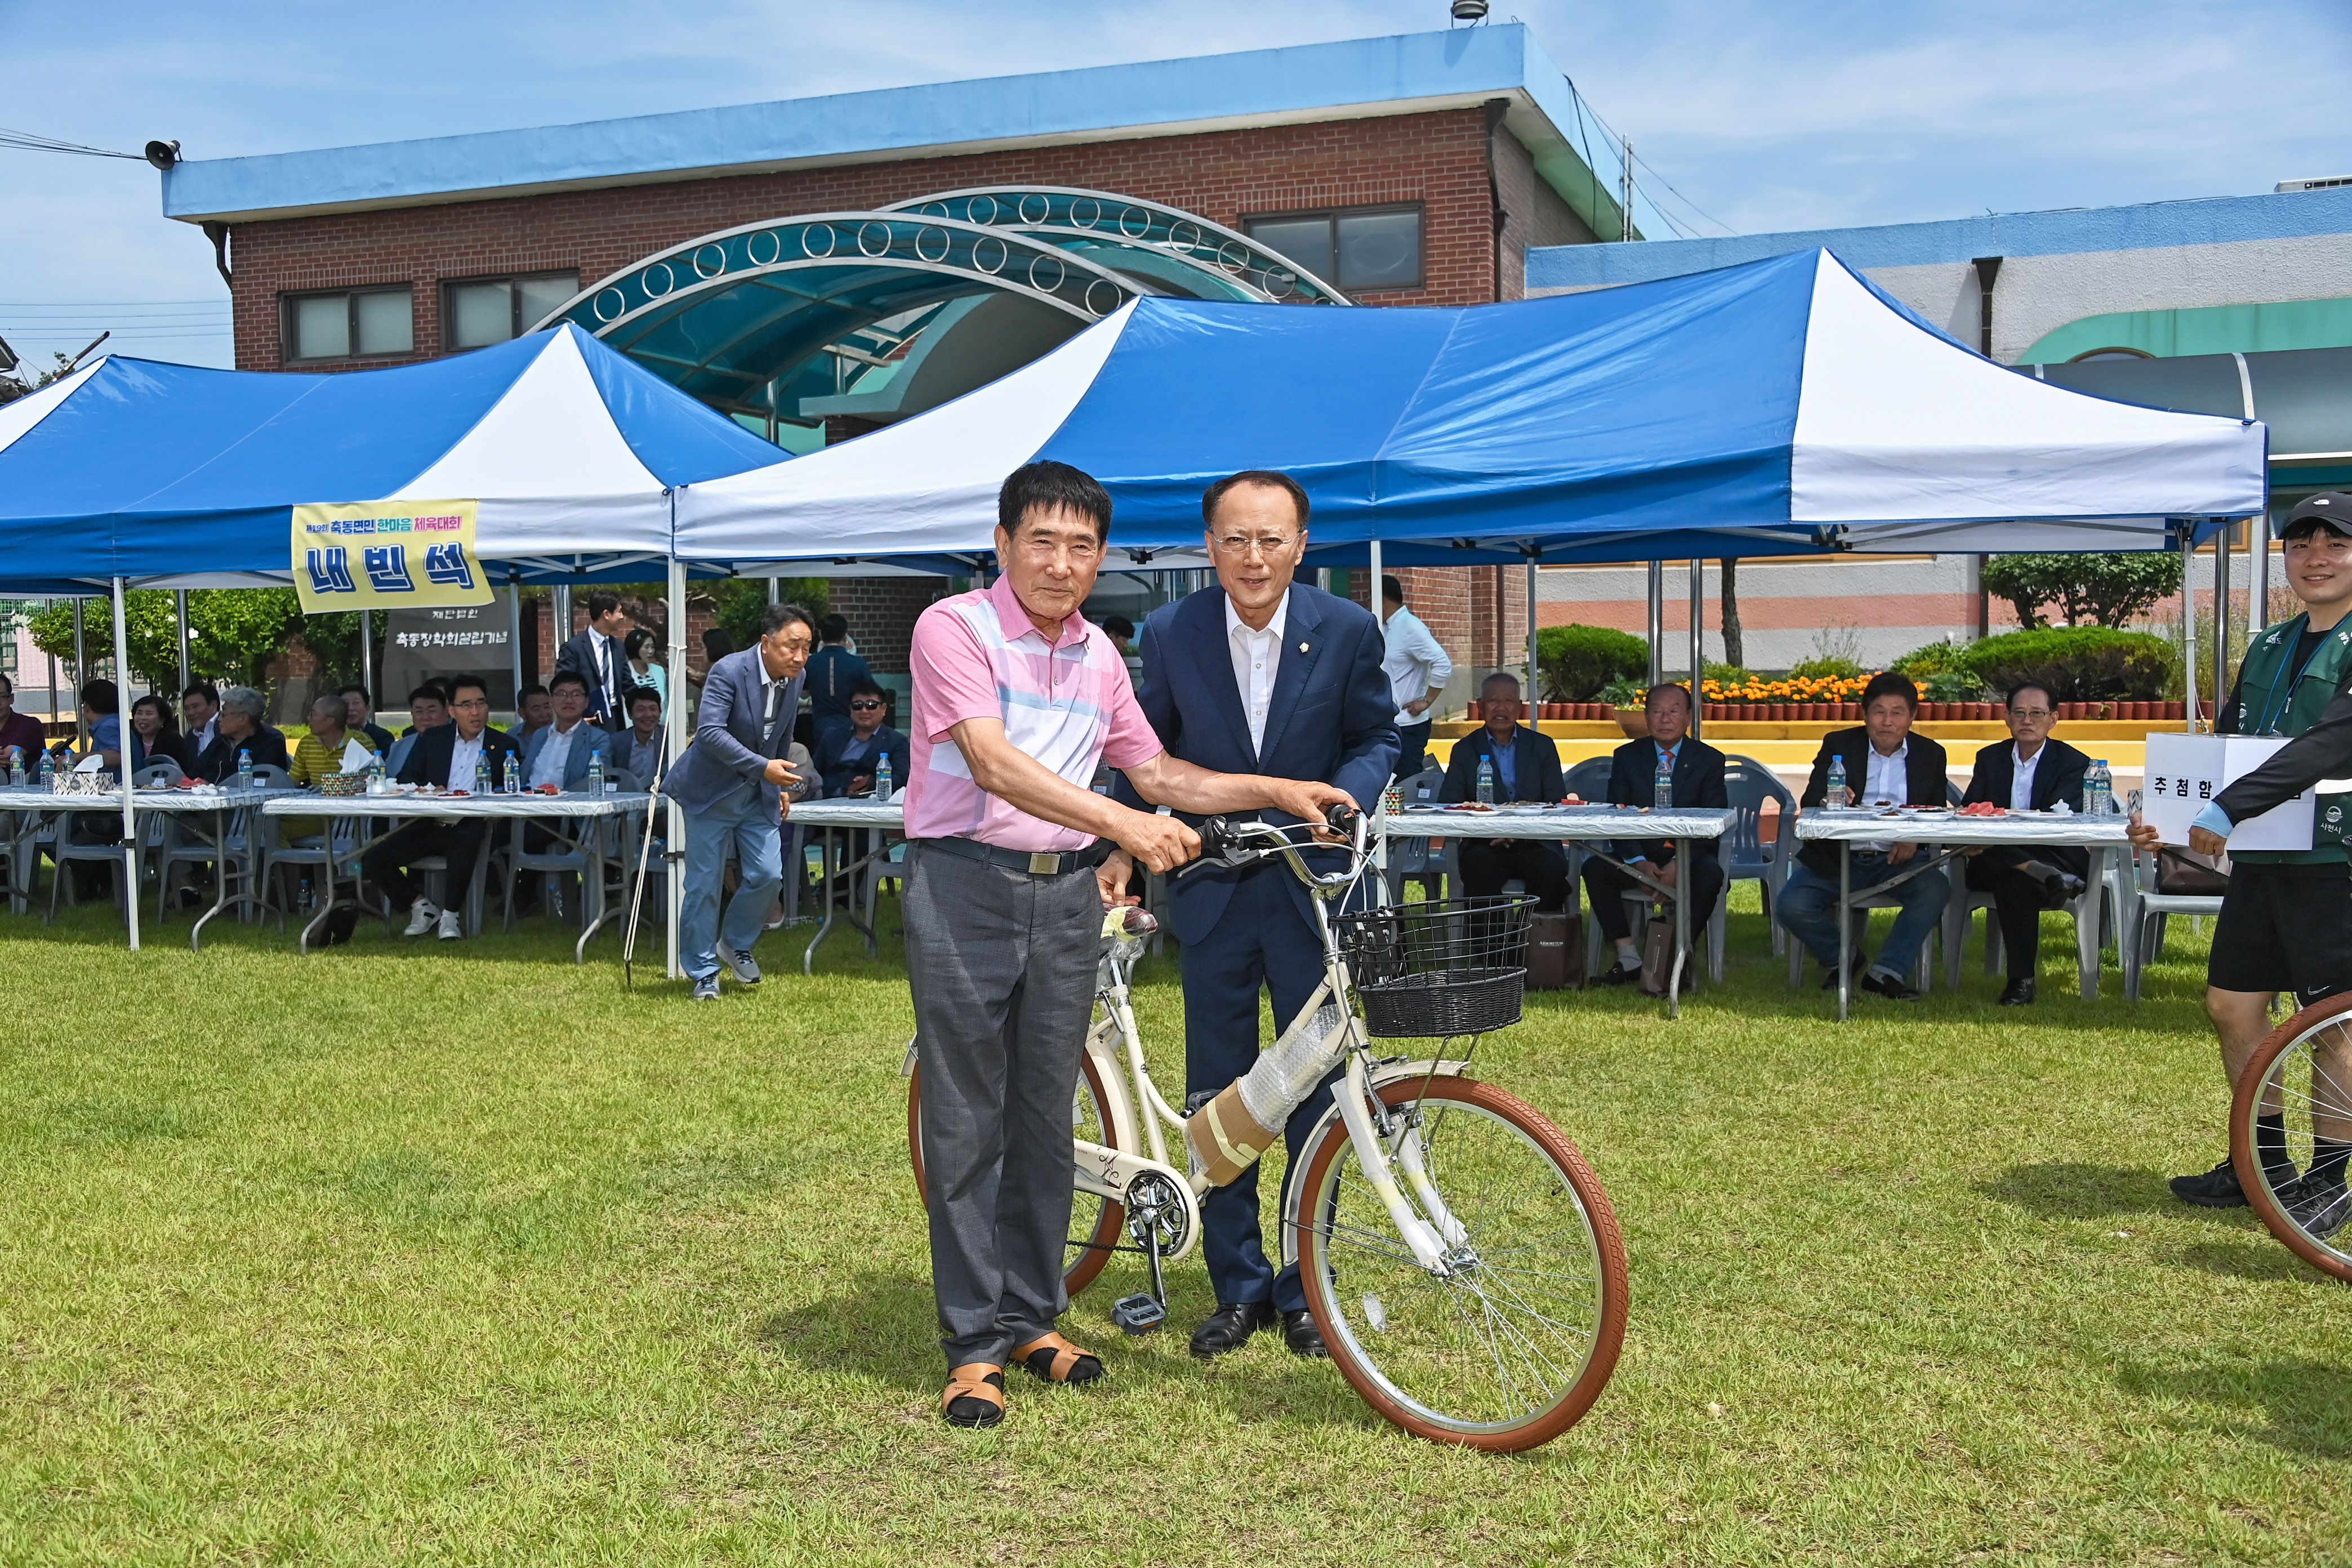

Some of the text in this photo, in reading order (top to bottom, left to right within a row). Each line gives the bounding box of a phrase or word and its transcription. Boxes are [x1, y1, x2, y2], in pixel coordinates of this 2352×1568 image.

[306, 516, 462, 534] 제19회 축동면민 한마음 체육대회
[306, 541, 475, 594] 내빈석
[432, 609, 478, 620] 재단법인
[396, 631, 507, 648] 축동장학회설립기념
[2154, 777, 2212, 799] 추첨함
[2320, 822, 2341, 835] 사천시
